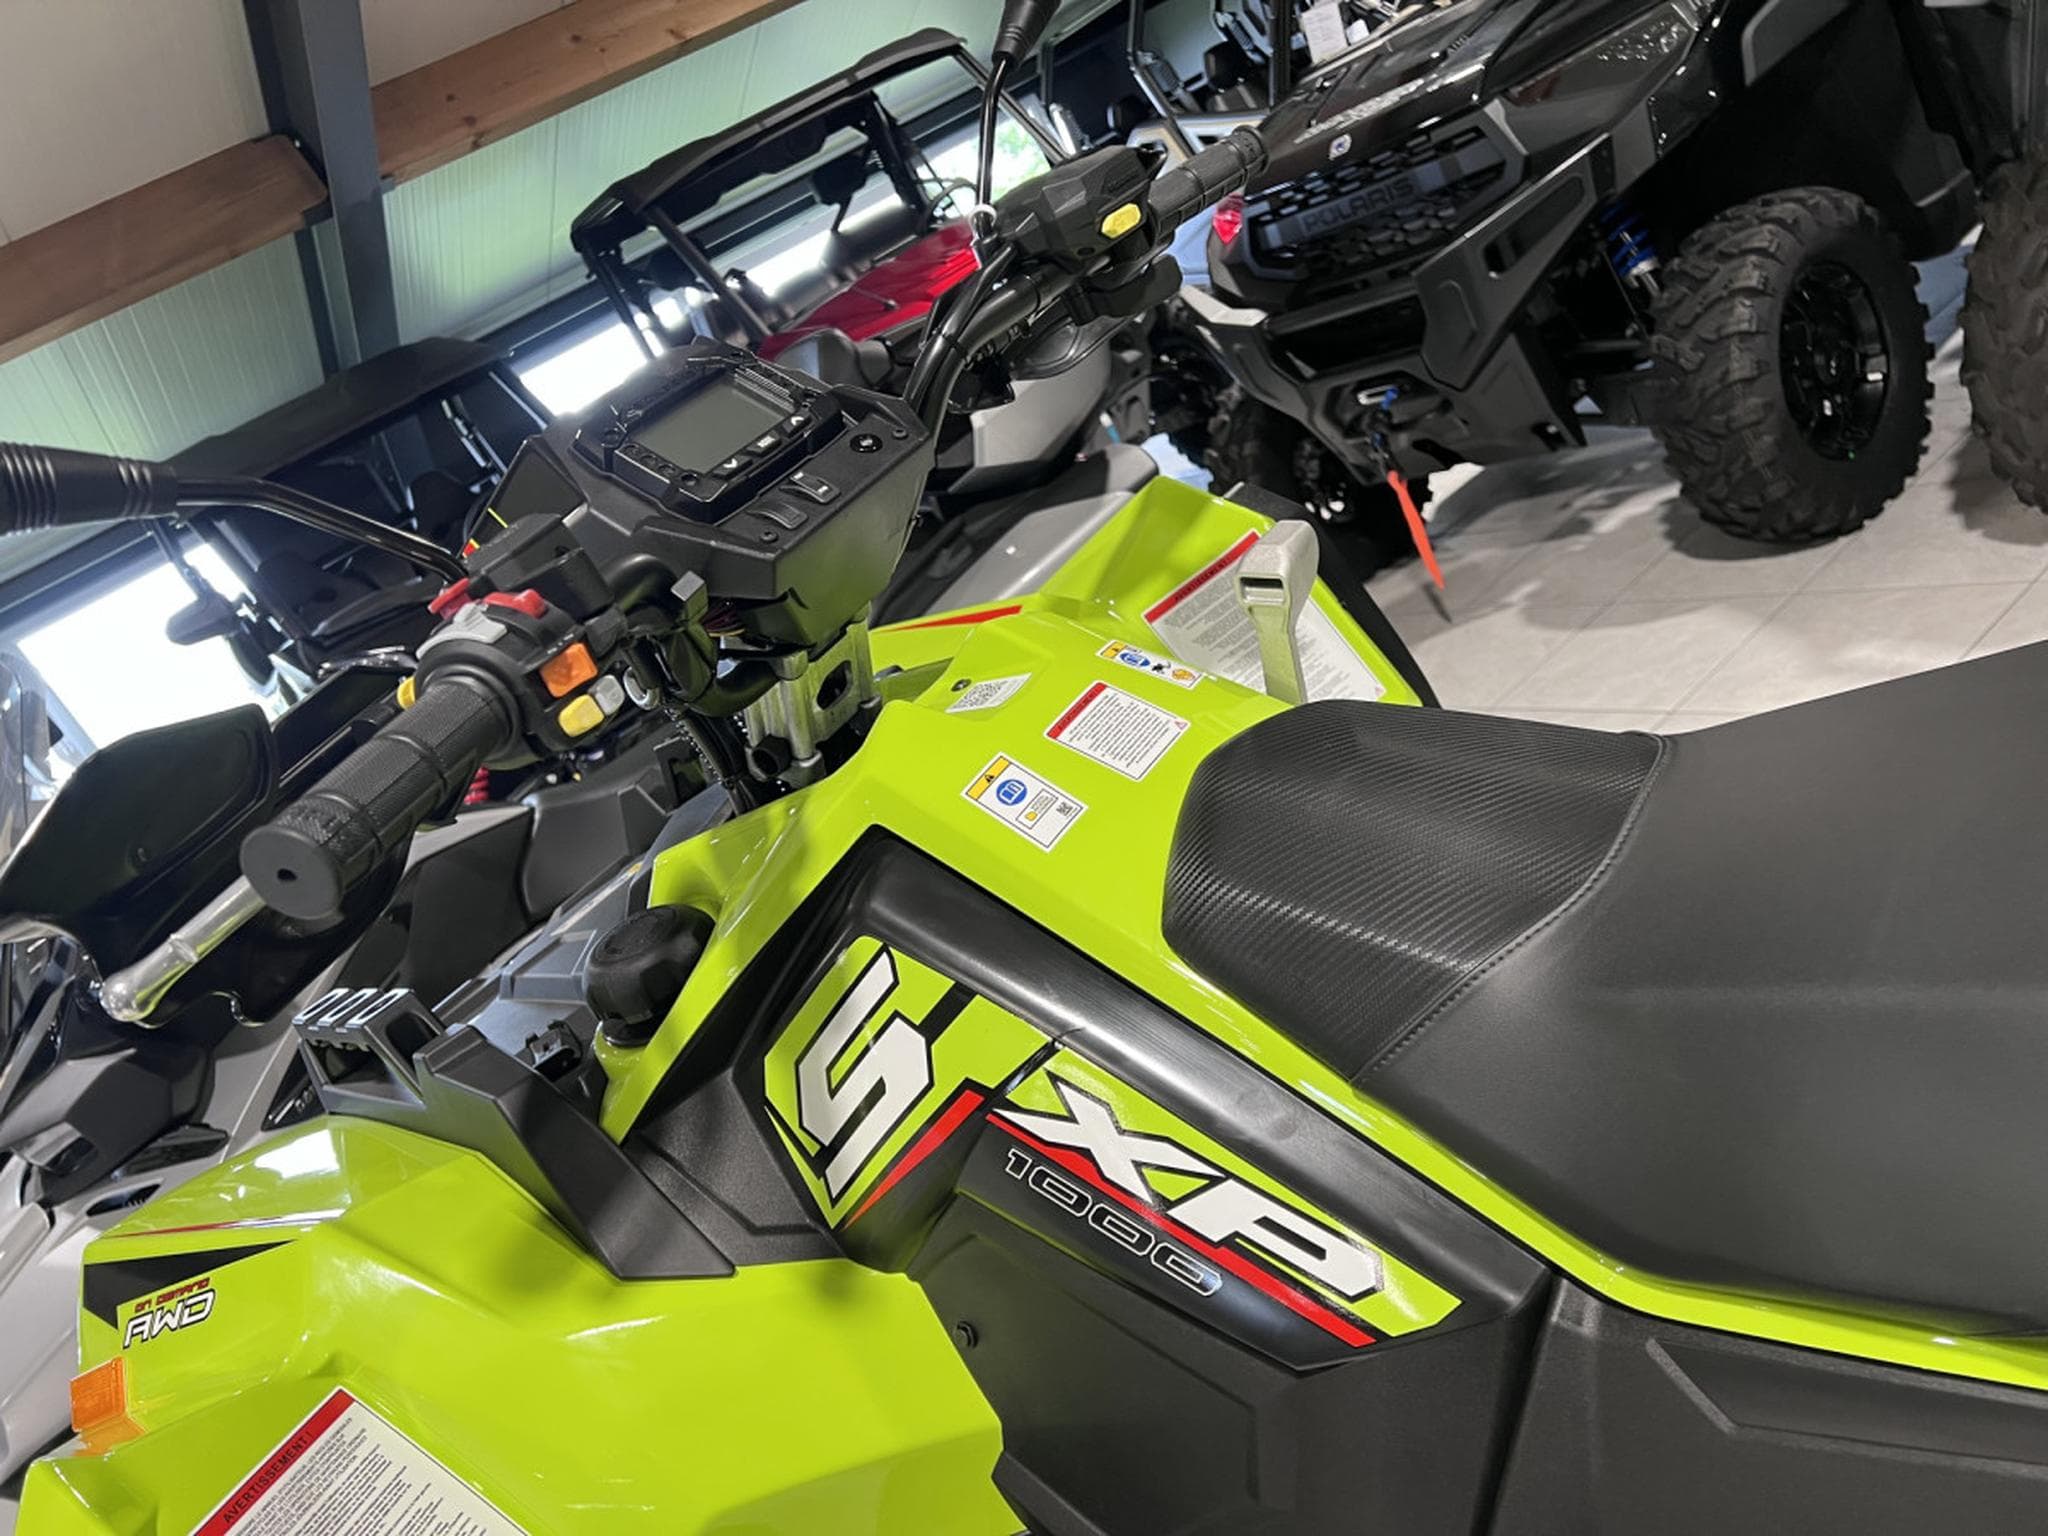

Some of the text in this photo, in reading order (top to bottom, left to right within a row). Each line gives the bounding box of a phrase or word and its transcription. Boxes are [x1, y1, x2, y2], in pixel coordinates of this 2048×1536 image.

[1304, 183, 1413, 233] POLARIS
[990, 1078, 1385, 1299] XP
[1004, 1147, 1223, 1297] 1000
[123, 1288, 215, 1350] AWD
[223, 1436, 308, 1523] AVERTISSEMENT
